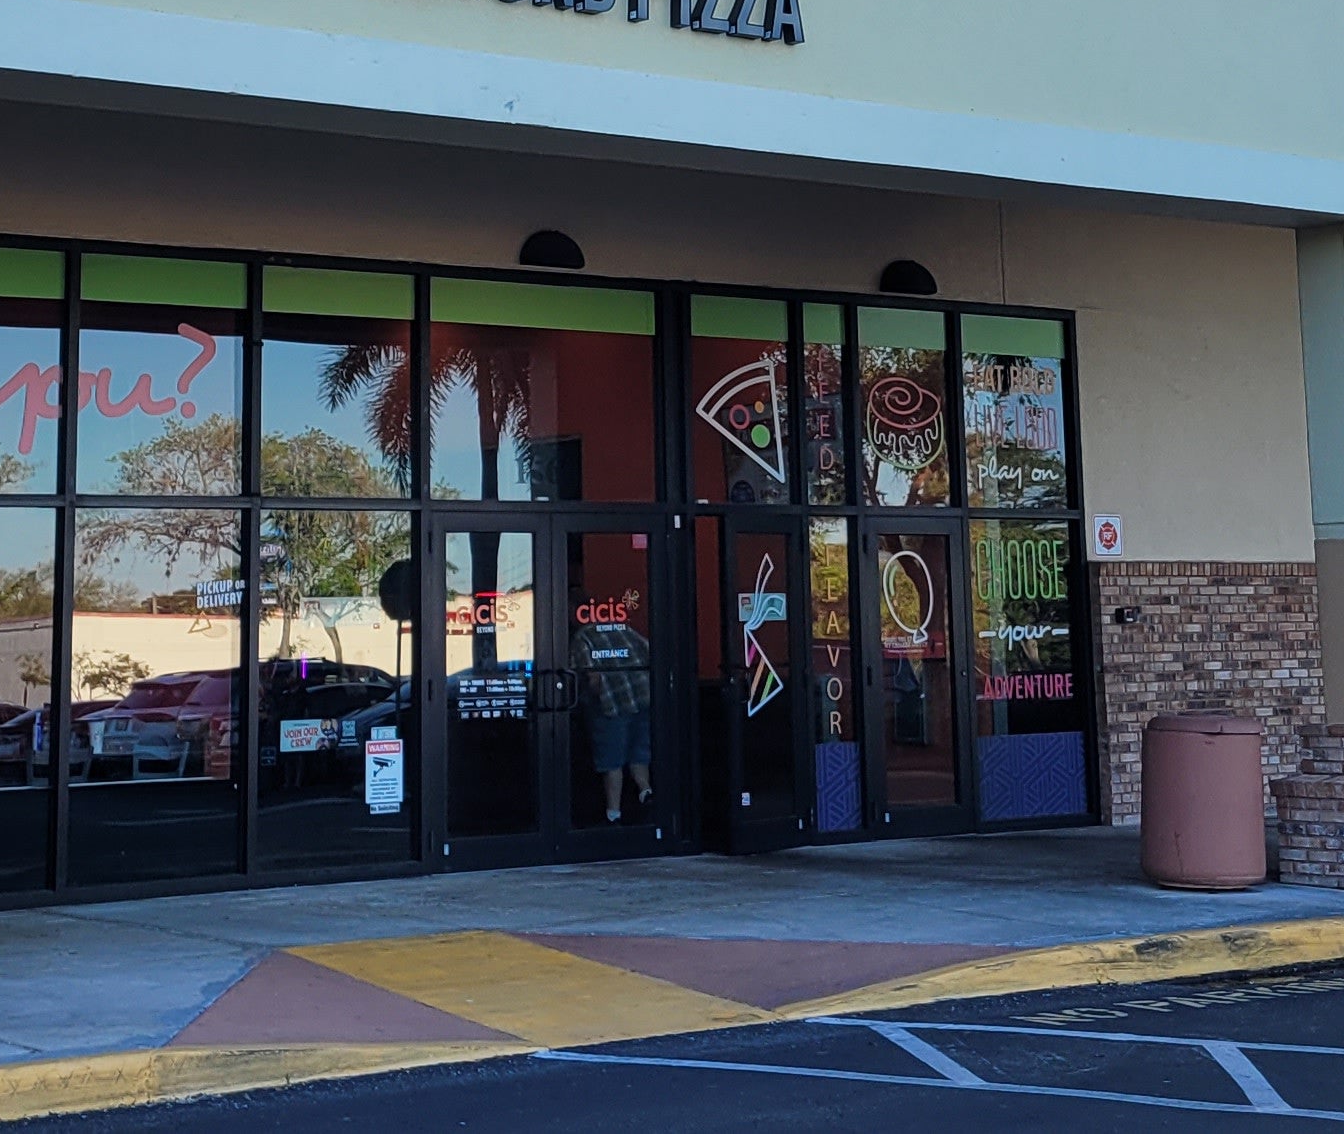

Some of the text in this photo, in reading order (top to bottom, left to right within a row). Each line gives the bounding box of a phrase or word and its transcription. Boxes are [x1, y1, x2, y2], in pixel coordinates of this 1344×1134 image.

[977, 457, 1059, 490] play on
[975, 539, 1067, 600] CHOOSE
[197, 579, 246, 596] PICKUP OR
[196, 592, 243, 609] DELIVERY
[576, 597, 627, 624] cicis
[591, 648, 630, 660] ENTRANCE
[983, 672, 1074, 700] ADVENTURE
[283, 727, 319, 739] JOIN OUR
[290, 736, 313, 748] CREW
[368, 742, 400, 753] WARNING
[1008, 1007, 1128, 1026] NO
